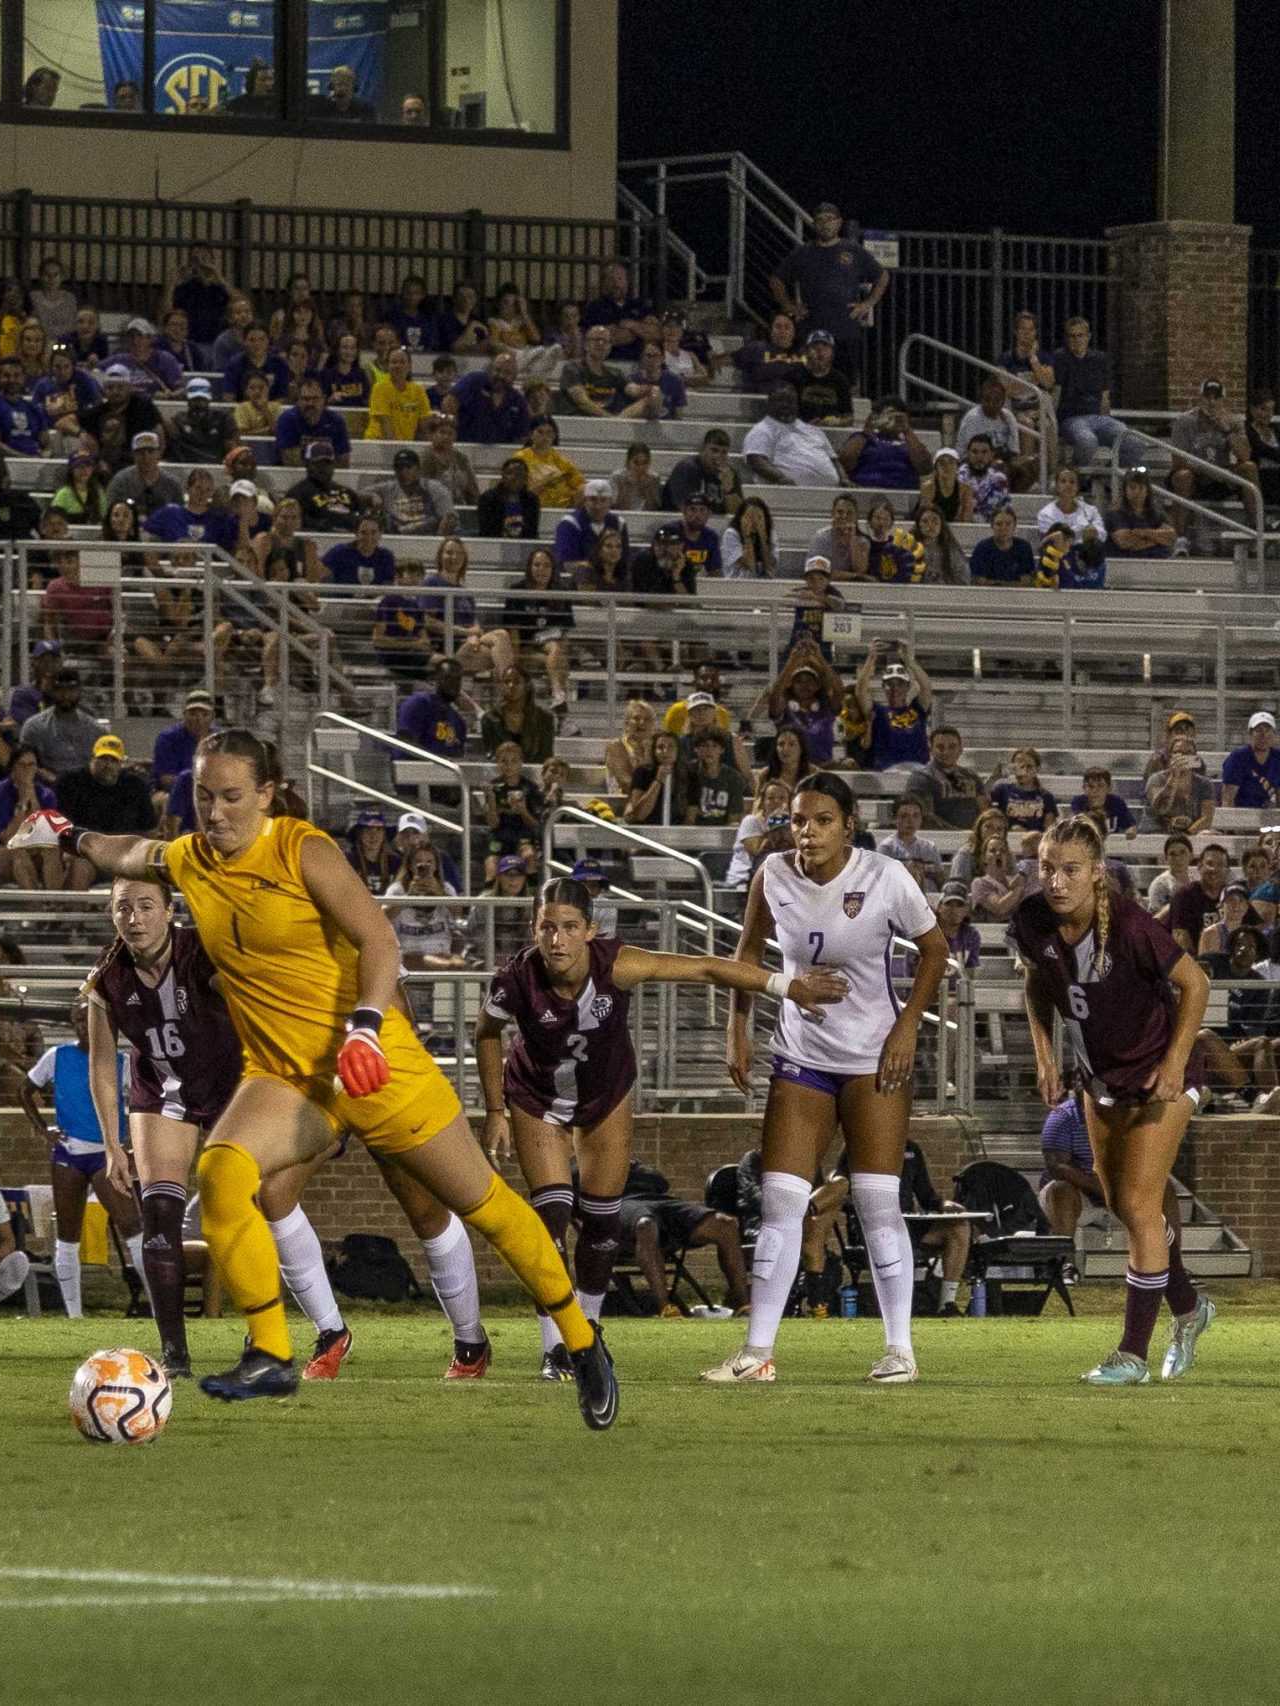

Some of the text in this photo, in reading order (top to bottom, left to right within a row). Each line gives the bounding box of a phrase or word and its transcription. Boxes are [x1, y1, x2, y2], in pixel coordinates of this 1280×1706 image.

[232, 911, 244, 953] 1
[809, 932, 826, 966] 2
[1067, 984, 1090, 1020] 6
[144, 1022, 186, 1059] 16
[566, 1033, 589, 1062] 2
